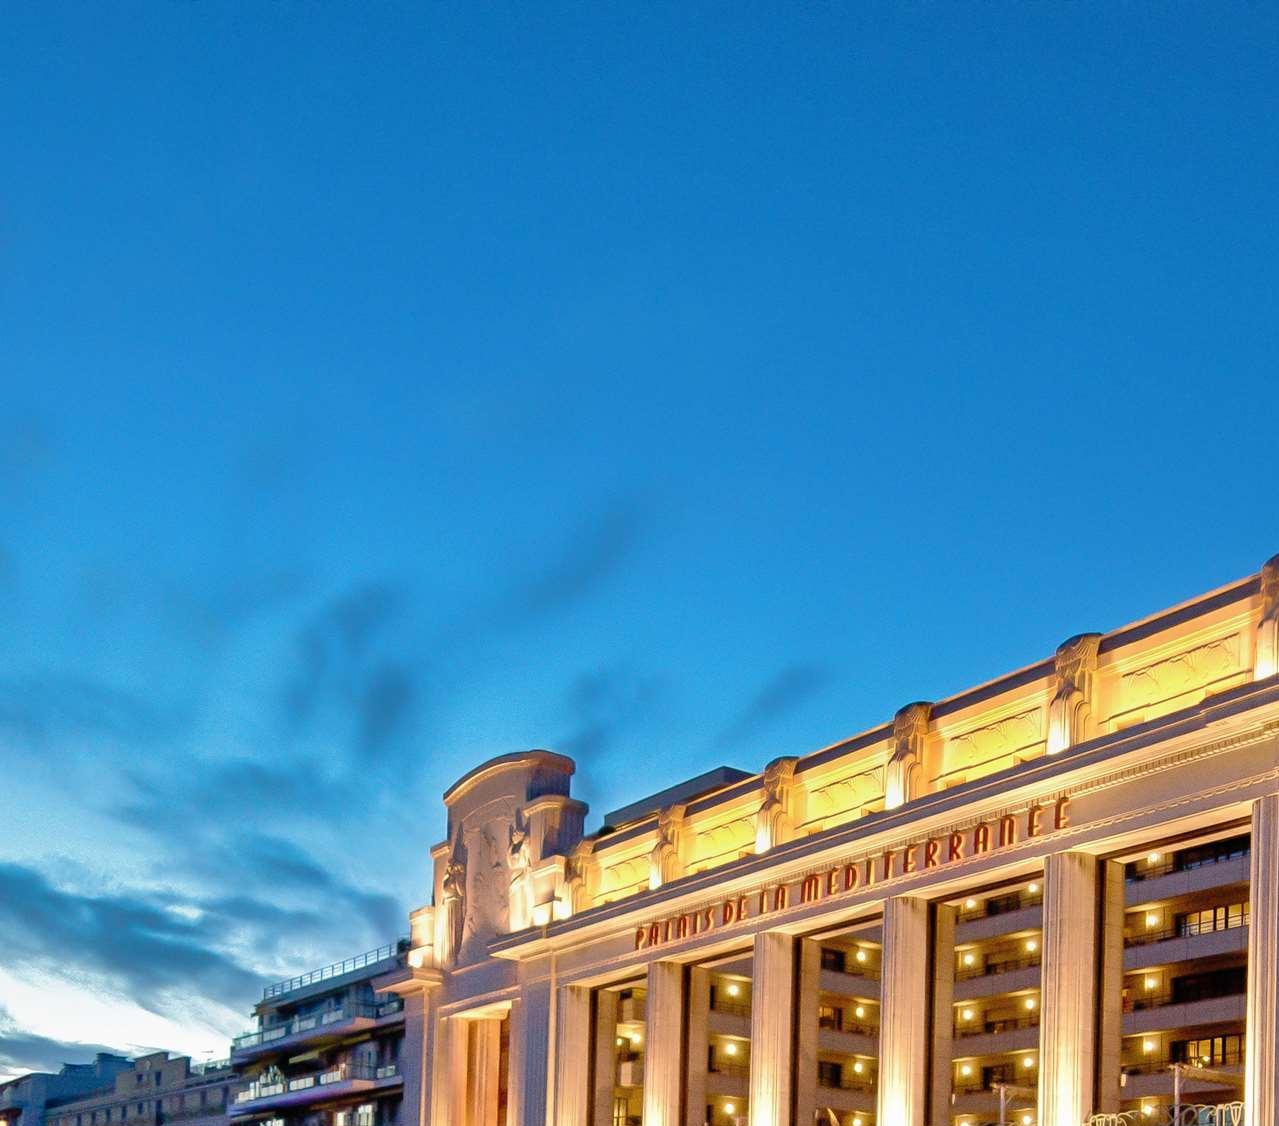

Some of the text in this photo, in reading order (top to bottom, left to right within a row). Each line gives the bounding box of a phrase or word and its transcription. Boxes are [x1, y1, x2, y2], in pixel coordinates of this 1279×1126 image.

[635, 906, 714, 951] PALAIS
[723, 896, 748, 926] DE
[760, 885, 791, 914] LA
